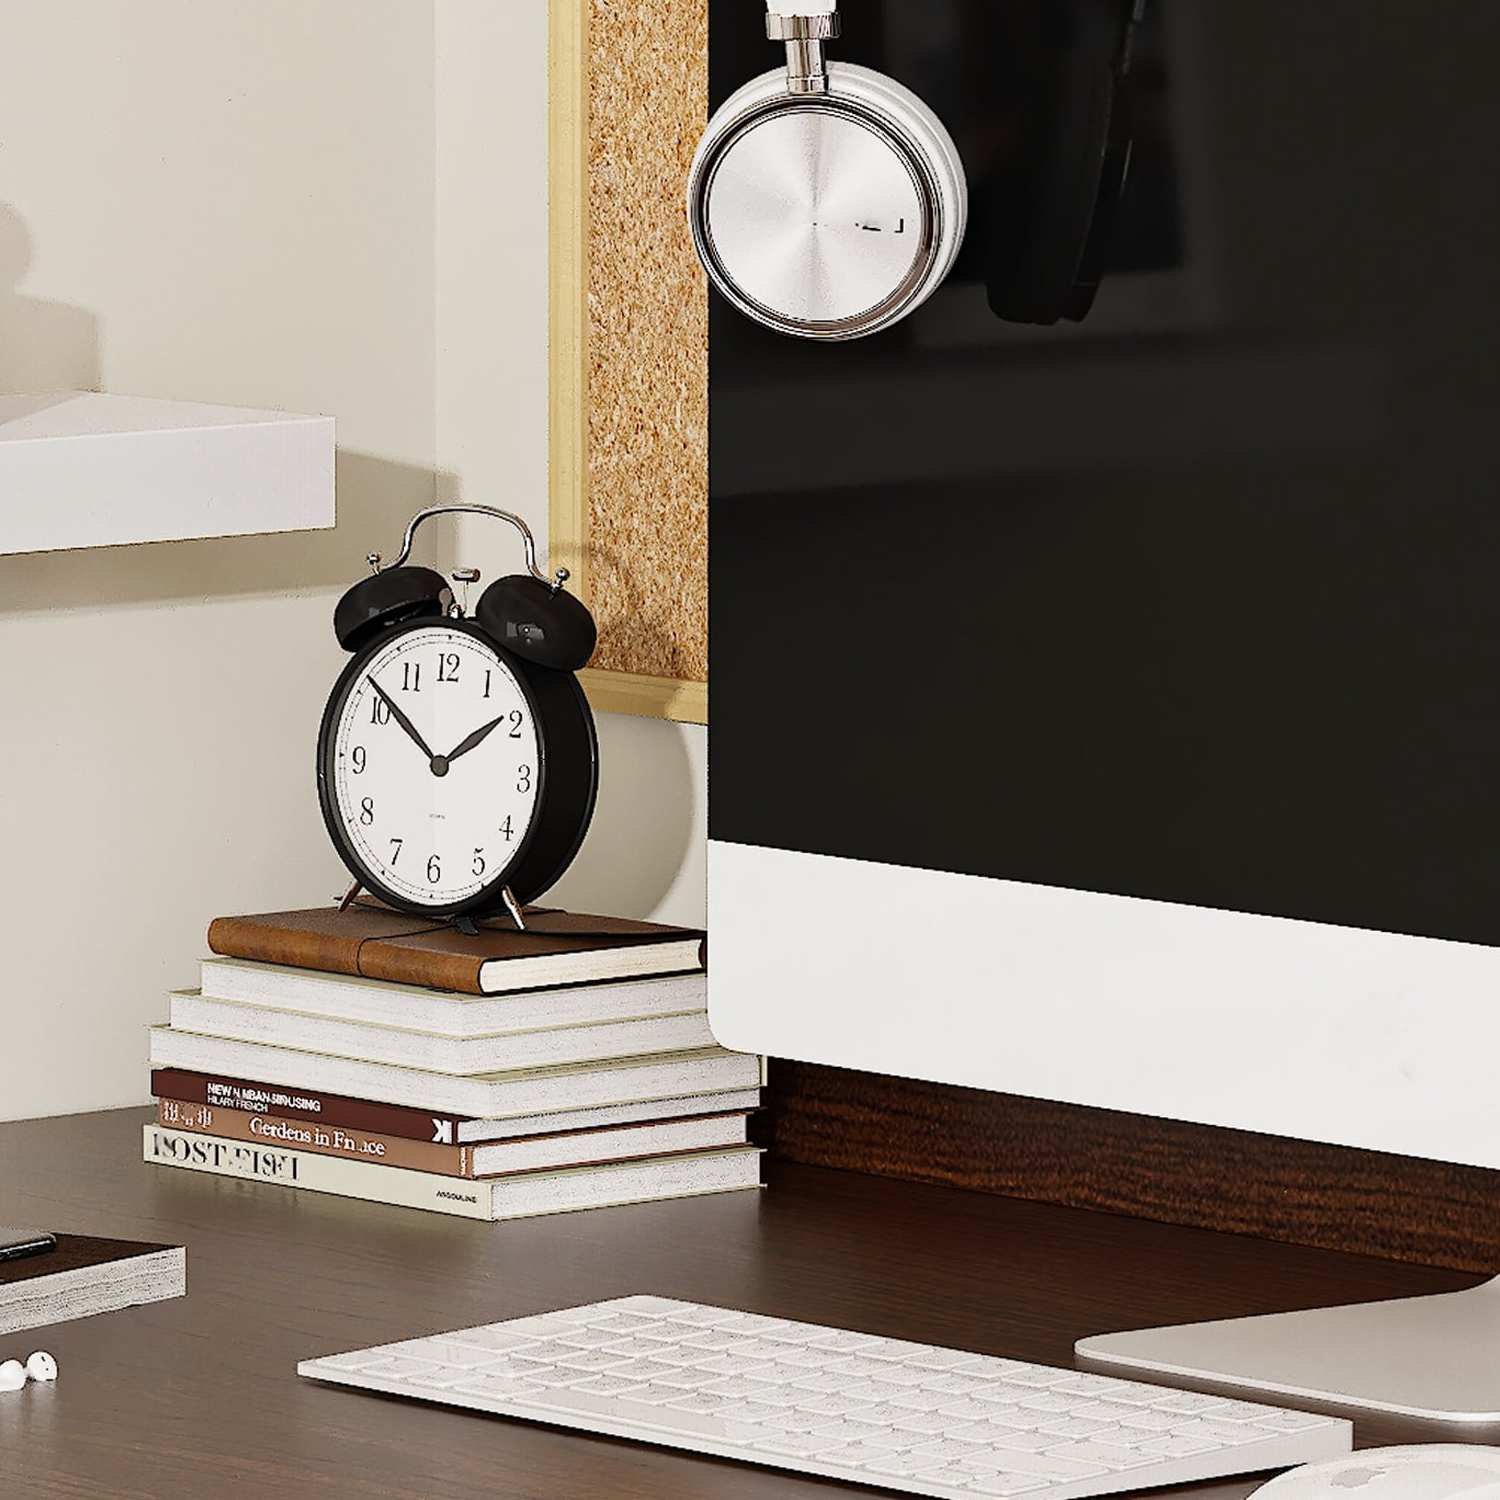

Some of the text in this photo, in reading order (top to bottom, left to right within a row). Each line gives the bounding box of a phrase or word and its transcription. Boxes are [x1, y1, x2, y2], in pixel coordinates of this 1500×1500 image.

[401, 662, 421, 692] 11
[436, 653, 460, 682] 12
[482, 670, 492, 698] 1
[370, 696, 390, 725] 10
[508, 710, 523, 738] 2
[352, 746, 367, 774] 9
[516, 764, 530, 793] 3
[360, 796, 374, 826] 8
[498, 815, 514, 842] 4
[390, 838, 403, 865] 7
[471, 848, 486, 876] 5
[426, 854, 441, 883] 6
[207, 1082, 232, 1097] NEW
[315, 1127, 330, 1147] in
